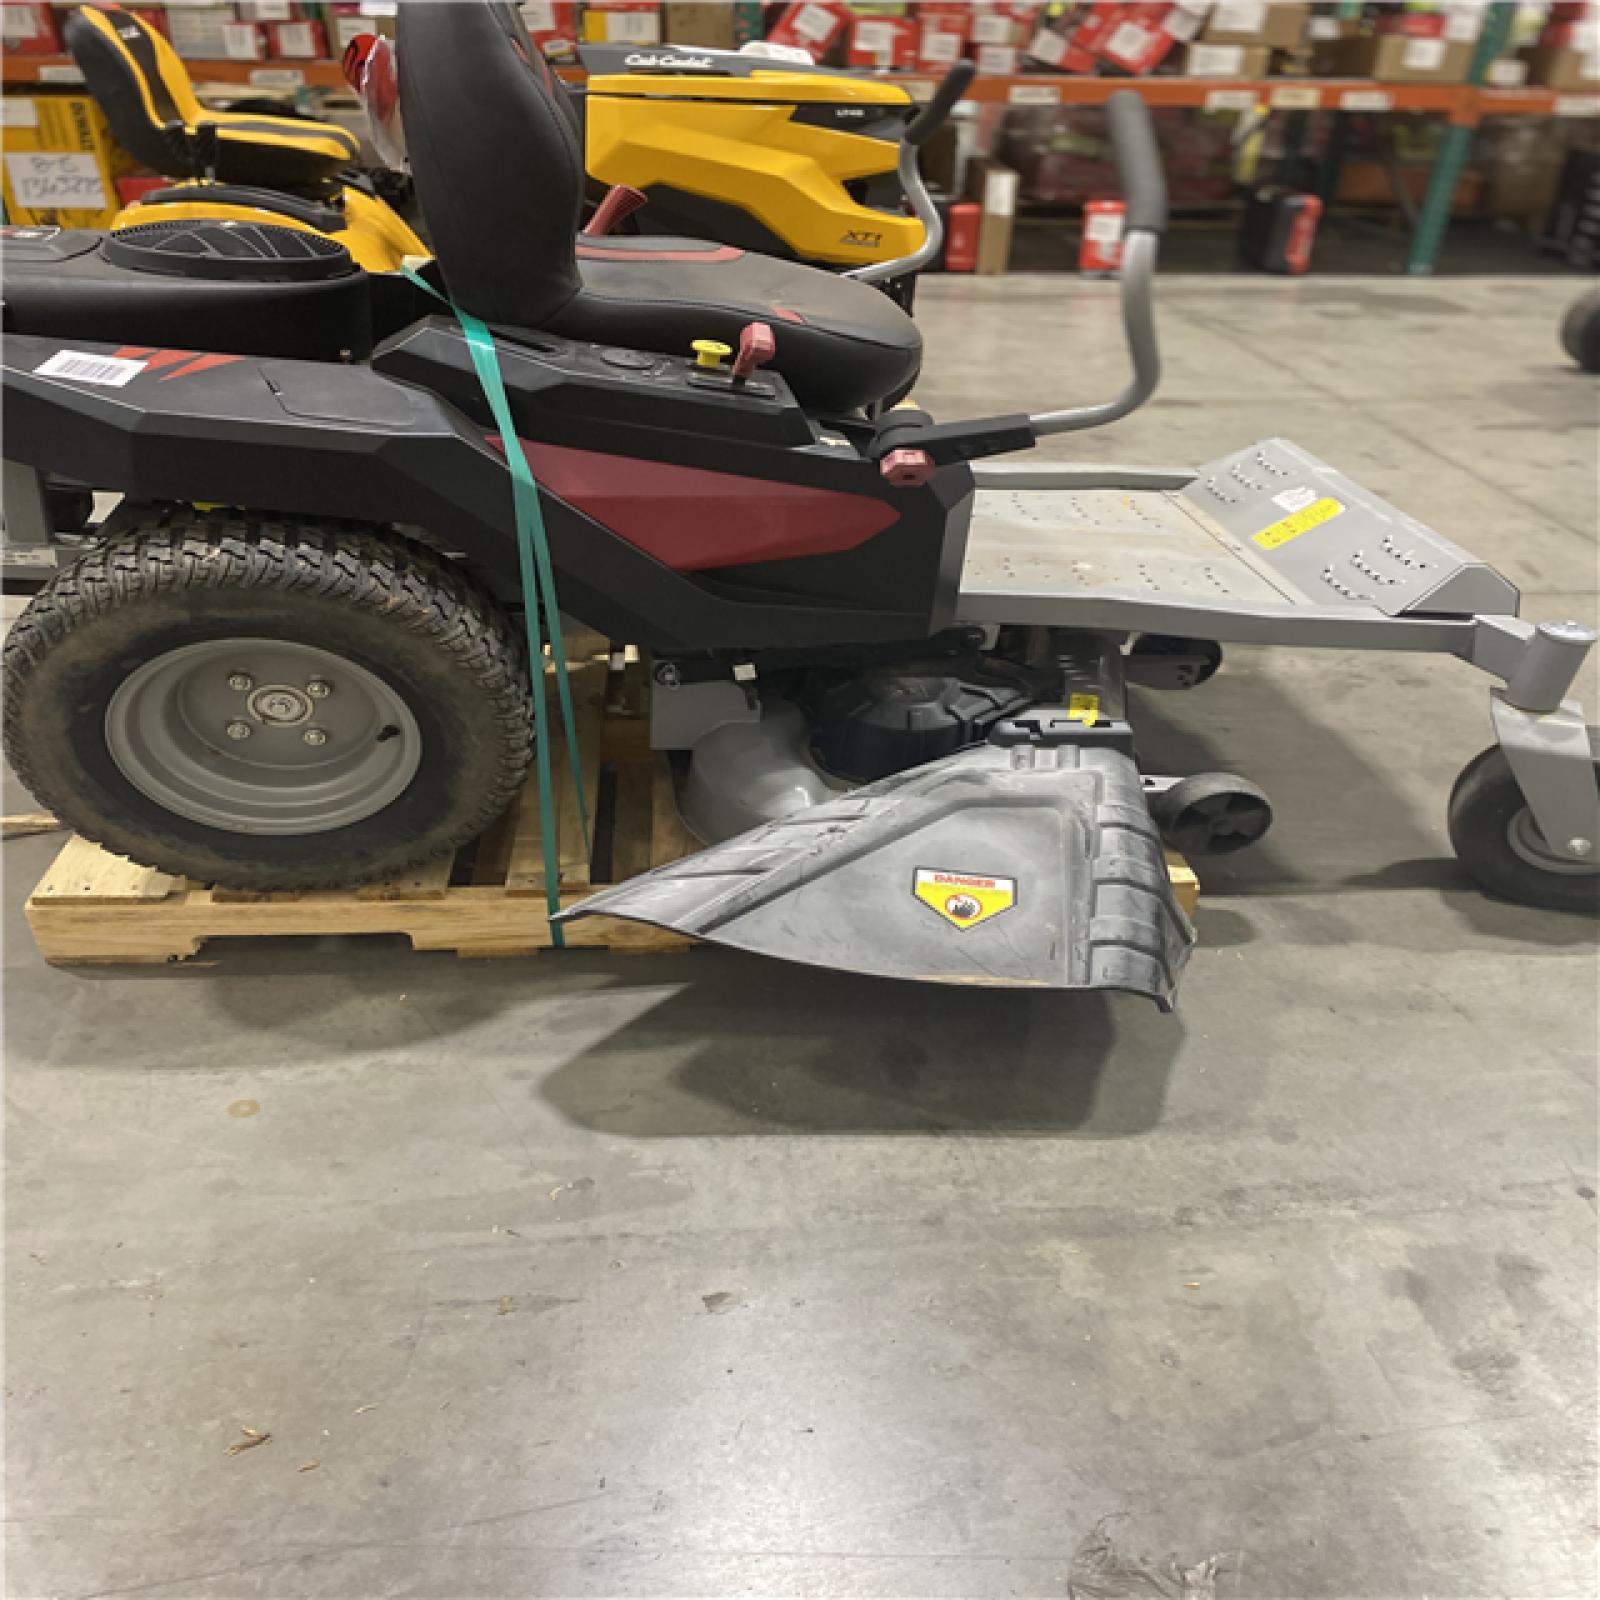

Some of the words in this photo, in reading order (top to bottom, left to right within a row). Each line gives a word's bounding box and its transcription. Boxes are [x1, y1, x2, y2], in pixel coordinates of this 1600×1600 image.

[624, 54, 657, 66] Cub
[659, 54, 714, 68] Cadet
[934, 873, 996, 889] DANGER
